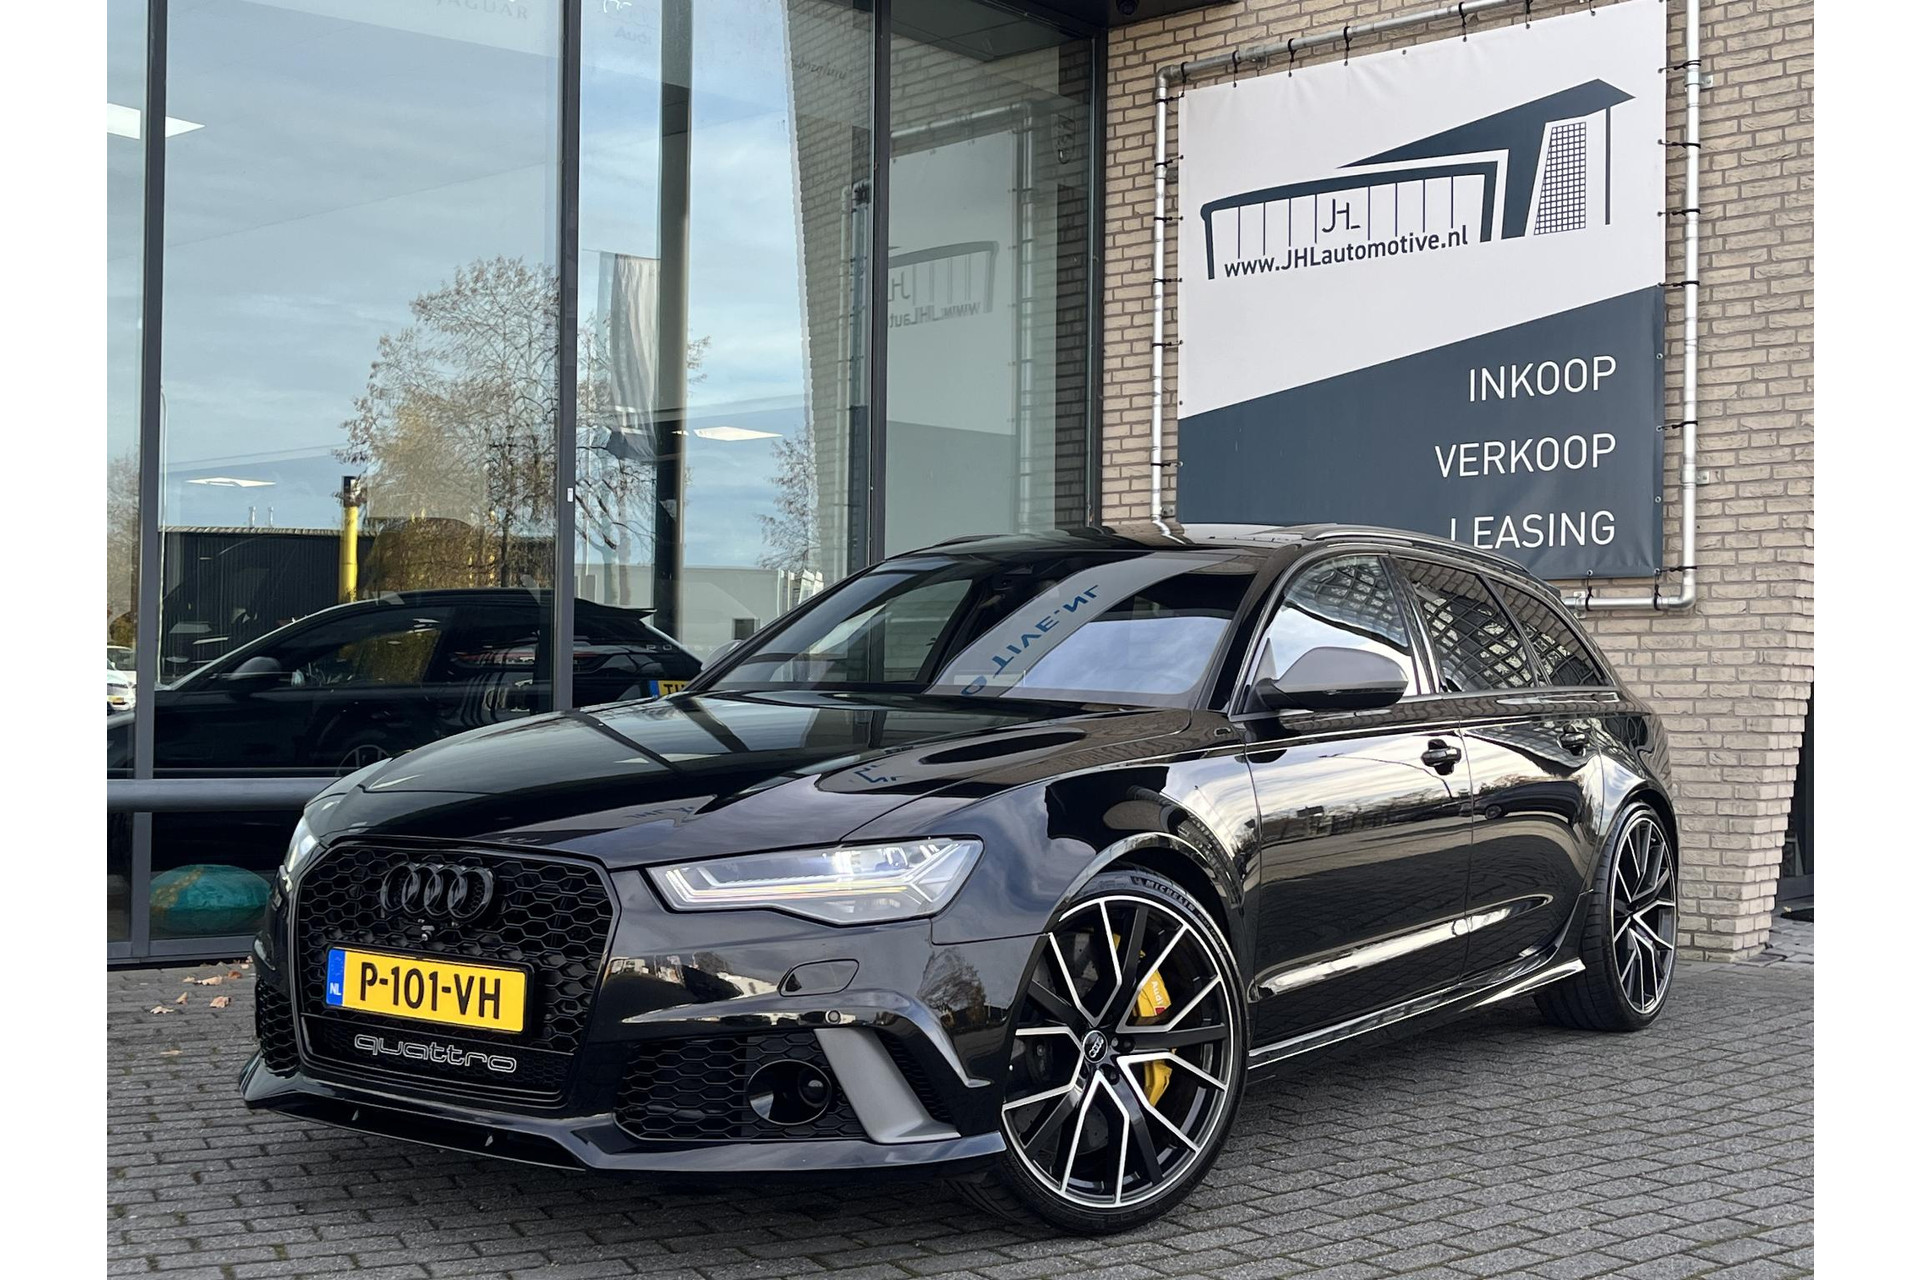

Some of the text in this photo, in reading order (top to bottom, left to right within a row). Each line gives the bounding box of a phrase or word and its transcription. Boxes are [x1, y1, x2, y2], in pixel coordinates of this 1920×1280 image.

[1321, 198, 1361, 233] JHL
[1224, 224, 1468, 278] www.JHLautomotive.nl
[1469, 355, 1617, 402] INKOOP
[1434, 432, 1617, 478] VERKOOP
[1145, 879, 1196, 913] MICHELIN
[329, 982, 342, 996] NL
[359, 961, 501, 1020] P-101-VH
[1151, 980, 1164, 1006] Audi
[354, 1033, 517, 1074] quattro
